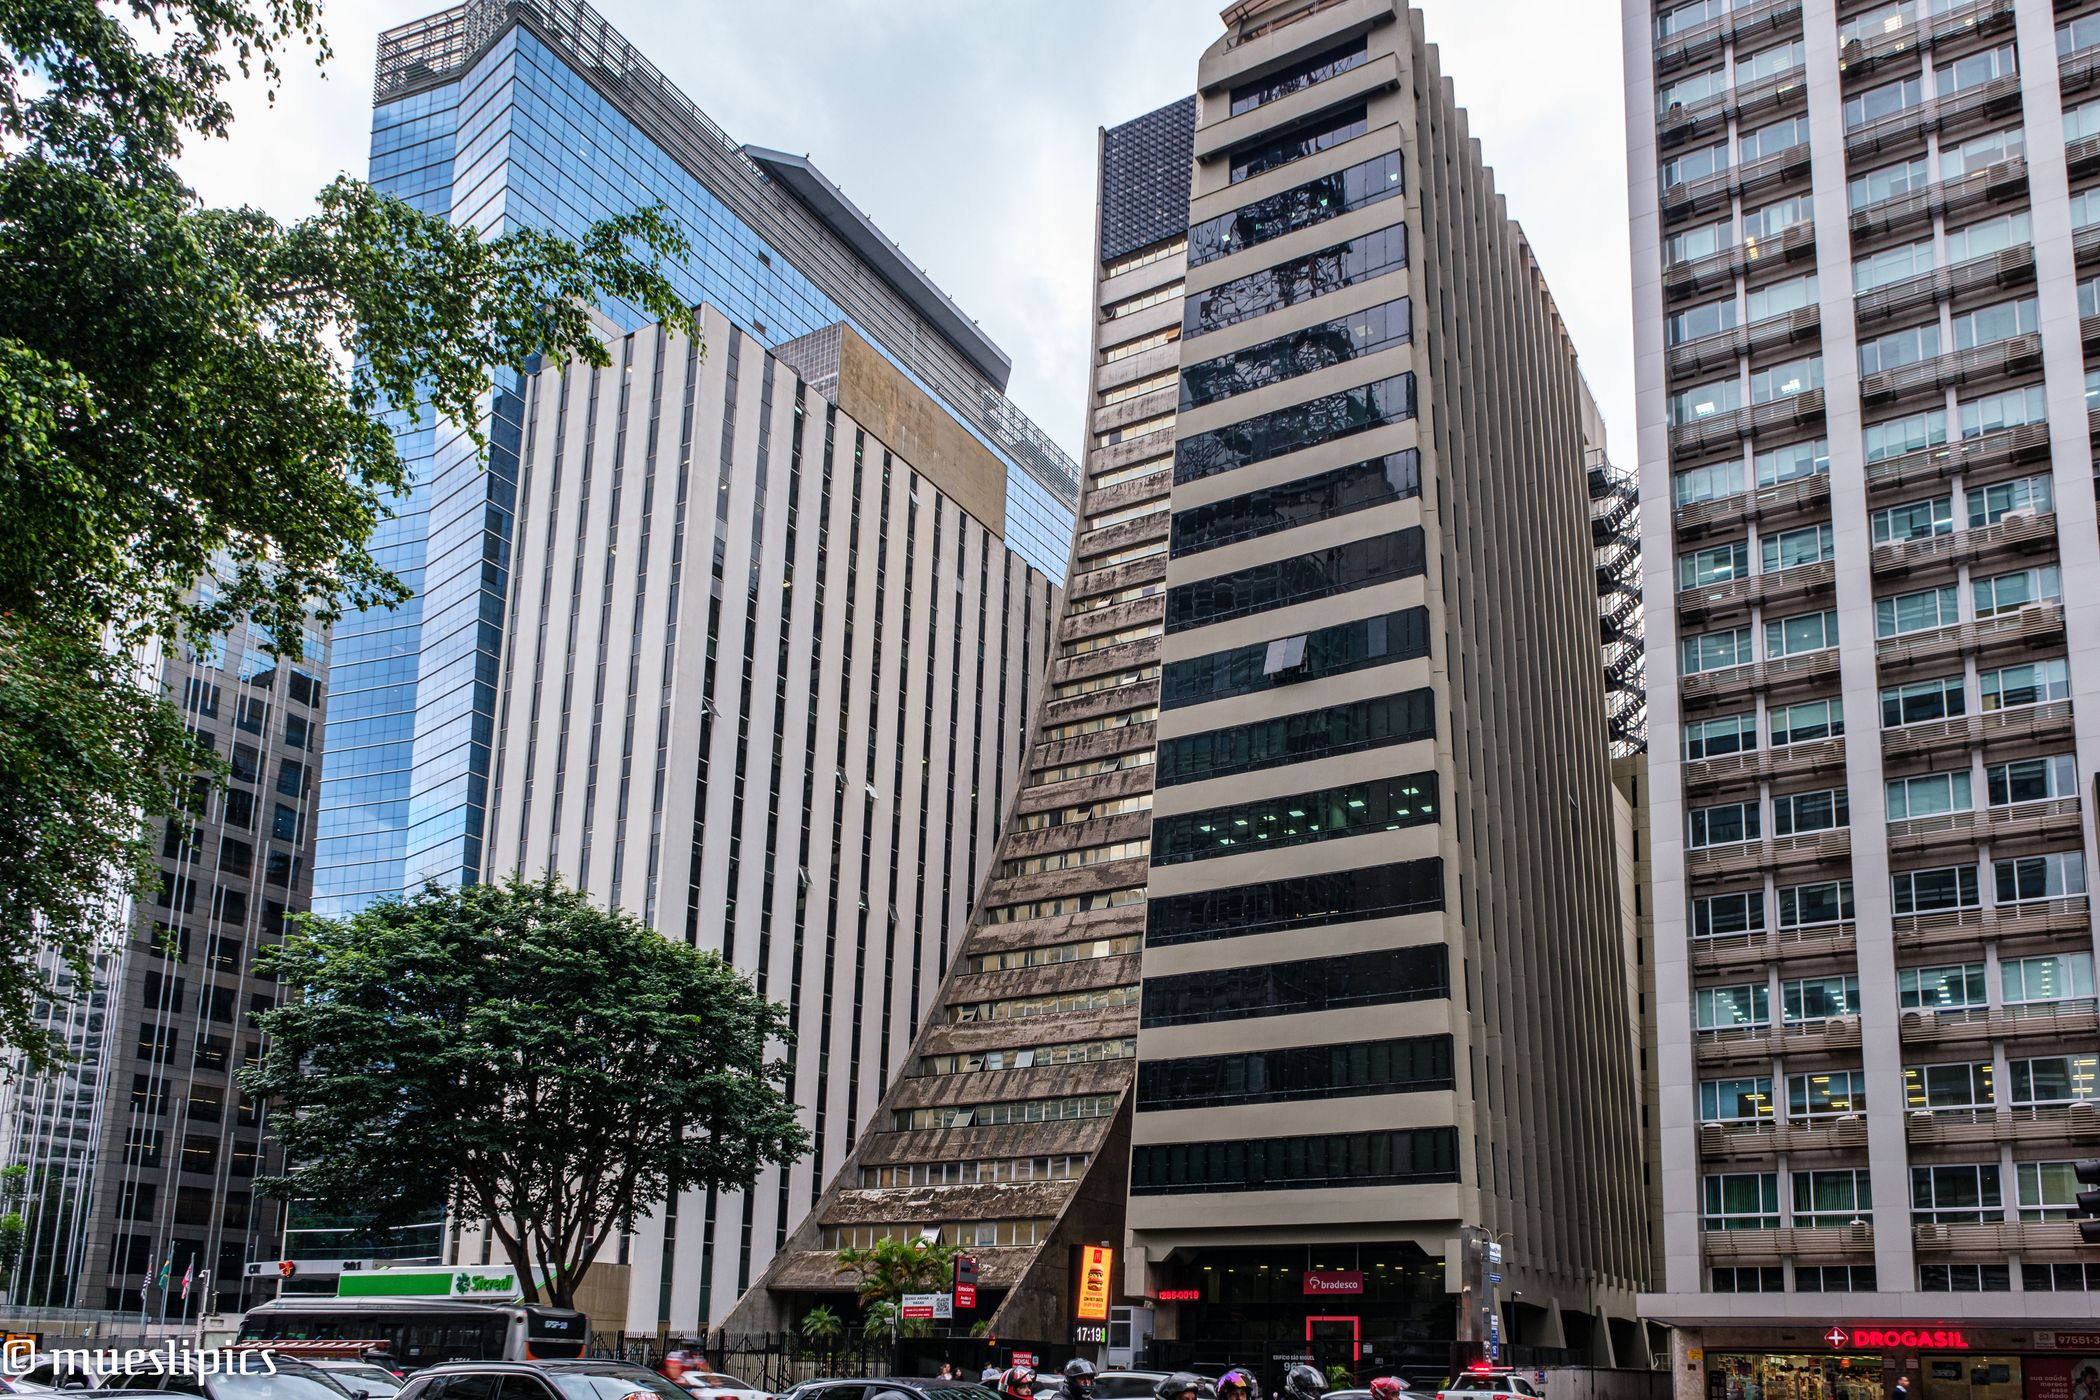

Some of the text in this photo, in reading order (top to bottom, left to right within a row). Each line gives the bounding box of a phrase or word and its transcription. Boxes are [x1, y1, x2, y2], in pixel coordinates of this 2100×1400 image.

[471, 1274, 514, 1291] Sicredi
[1321, 1280, 1358, 1289] bradesco
[1077, 1326, 1101, 1342] 17:19
[1854, 1330, 1969, 1348] DROGASIL
[1283, 1361, 1304, 1371] 96
